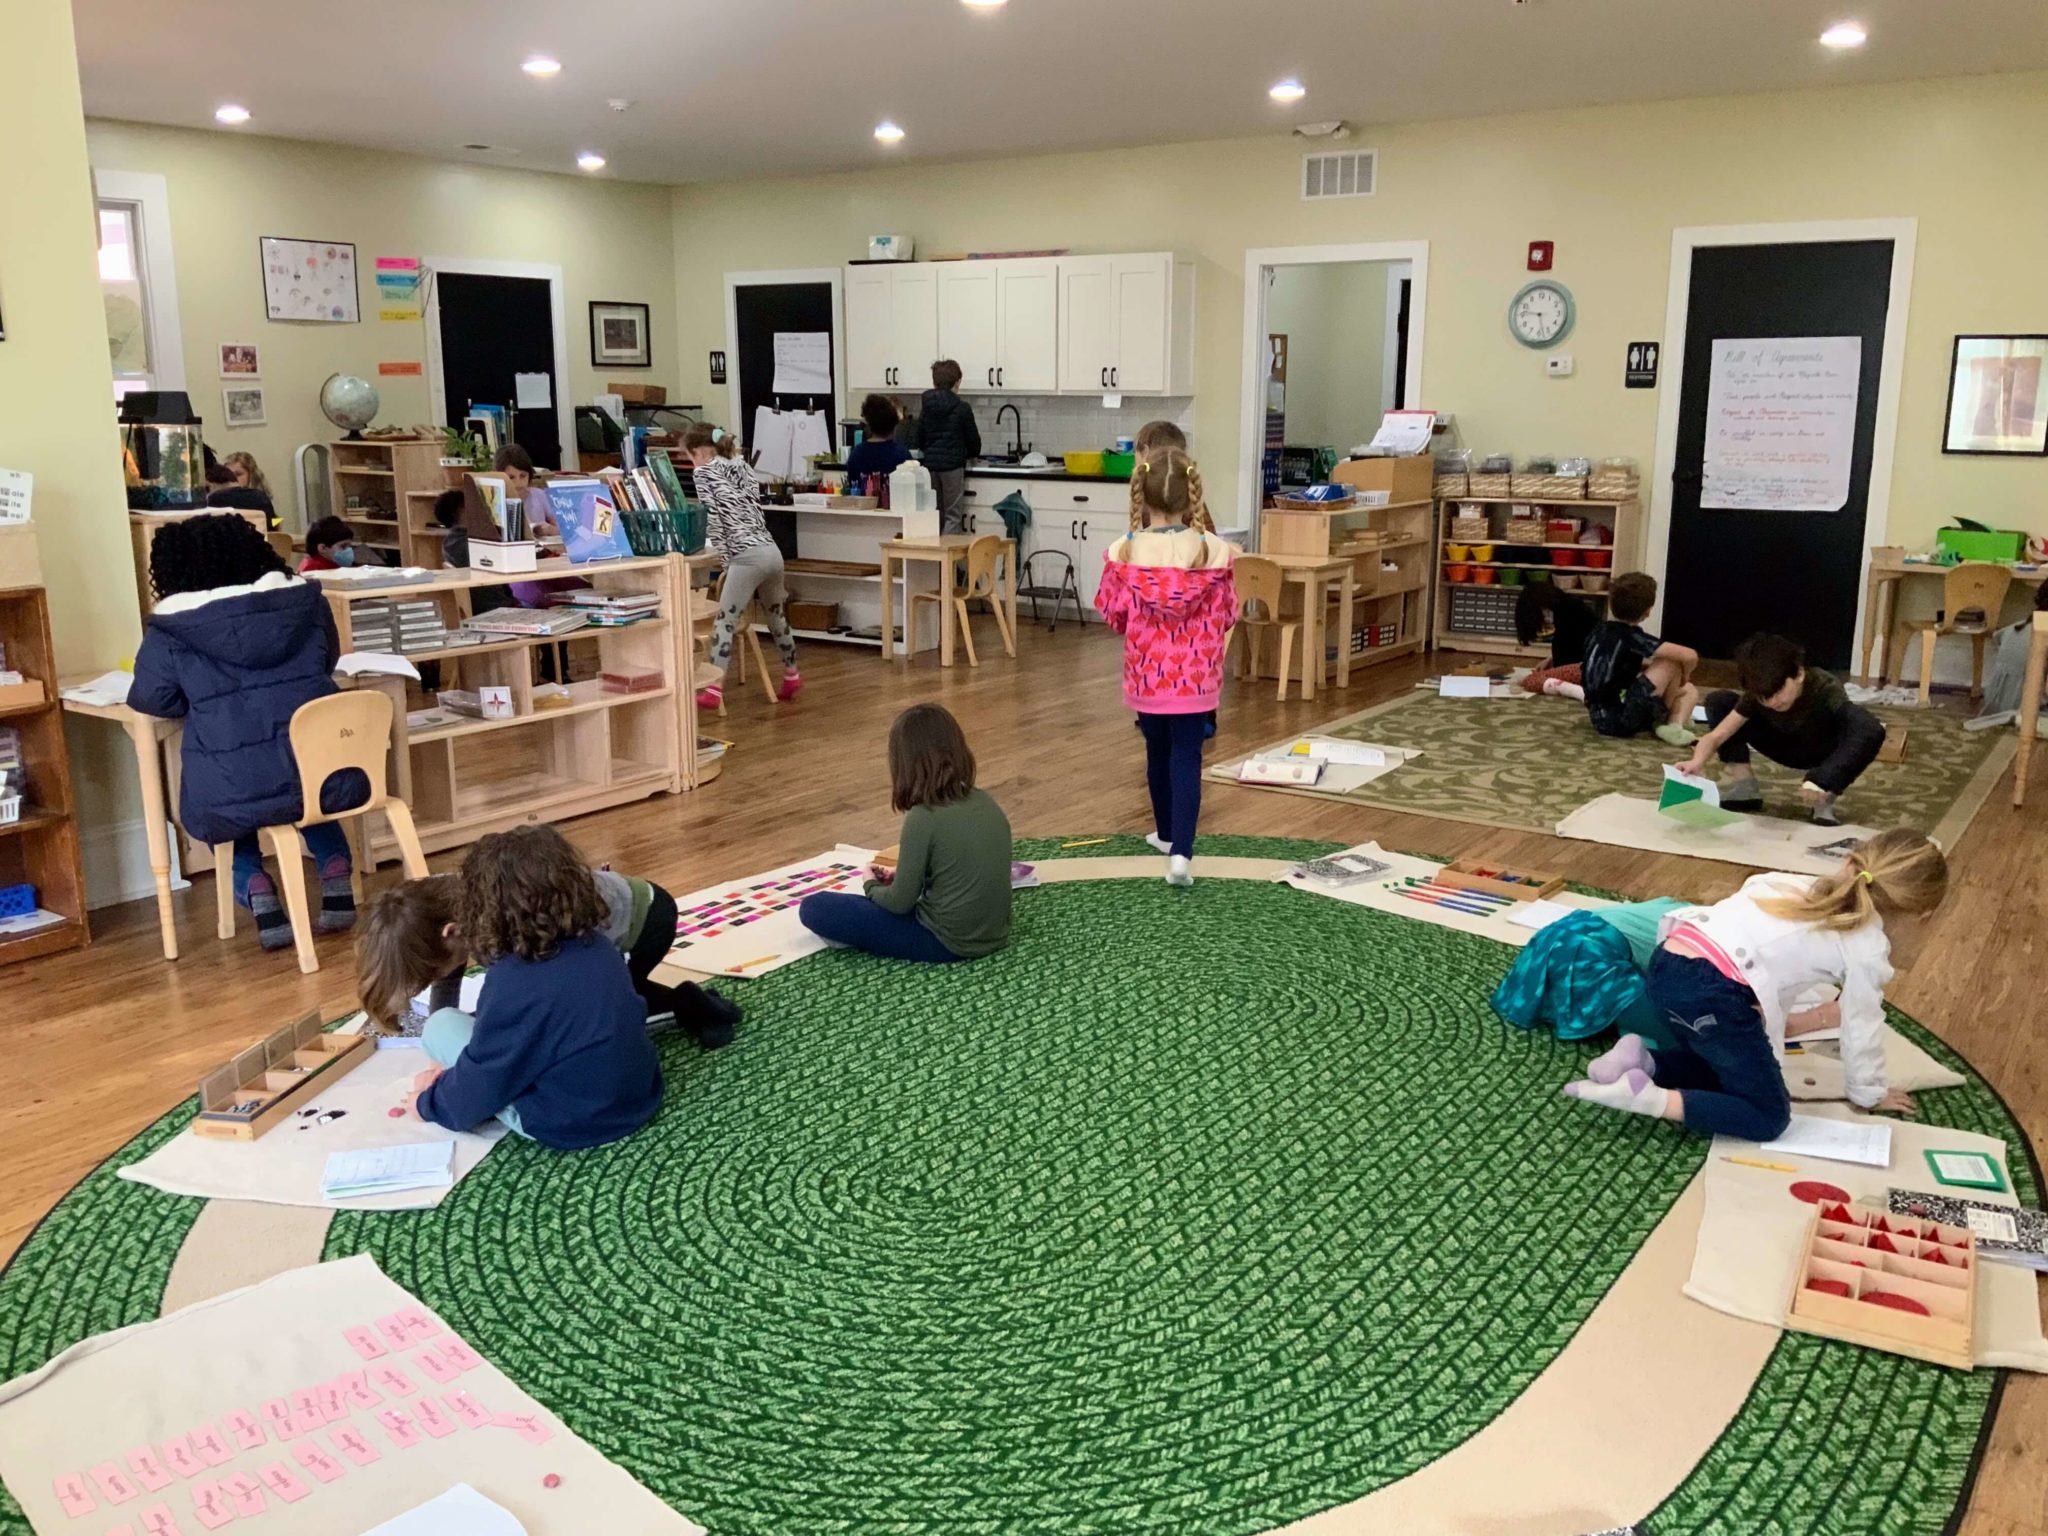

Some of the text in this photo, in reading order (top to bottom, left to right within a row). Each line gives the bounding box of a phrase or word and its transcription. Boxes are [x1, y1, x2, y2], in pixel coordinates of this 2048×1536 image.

[1538, 291, 1545, 299] 12
[1751, 350, 1765, 367] of
[1770, 350, 1824, 366] Agreements
